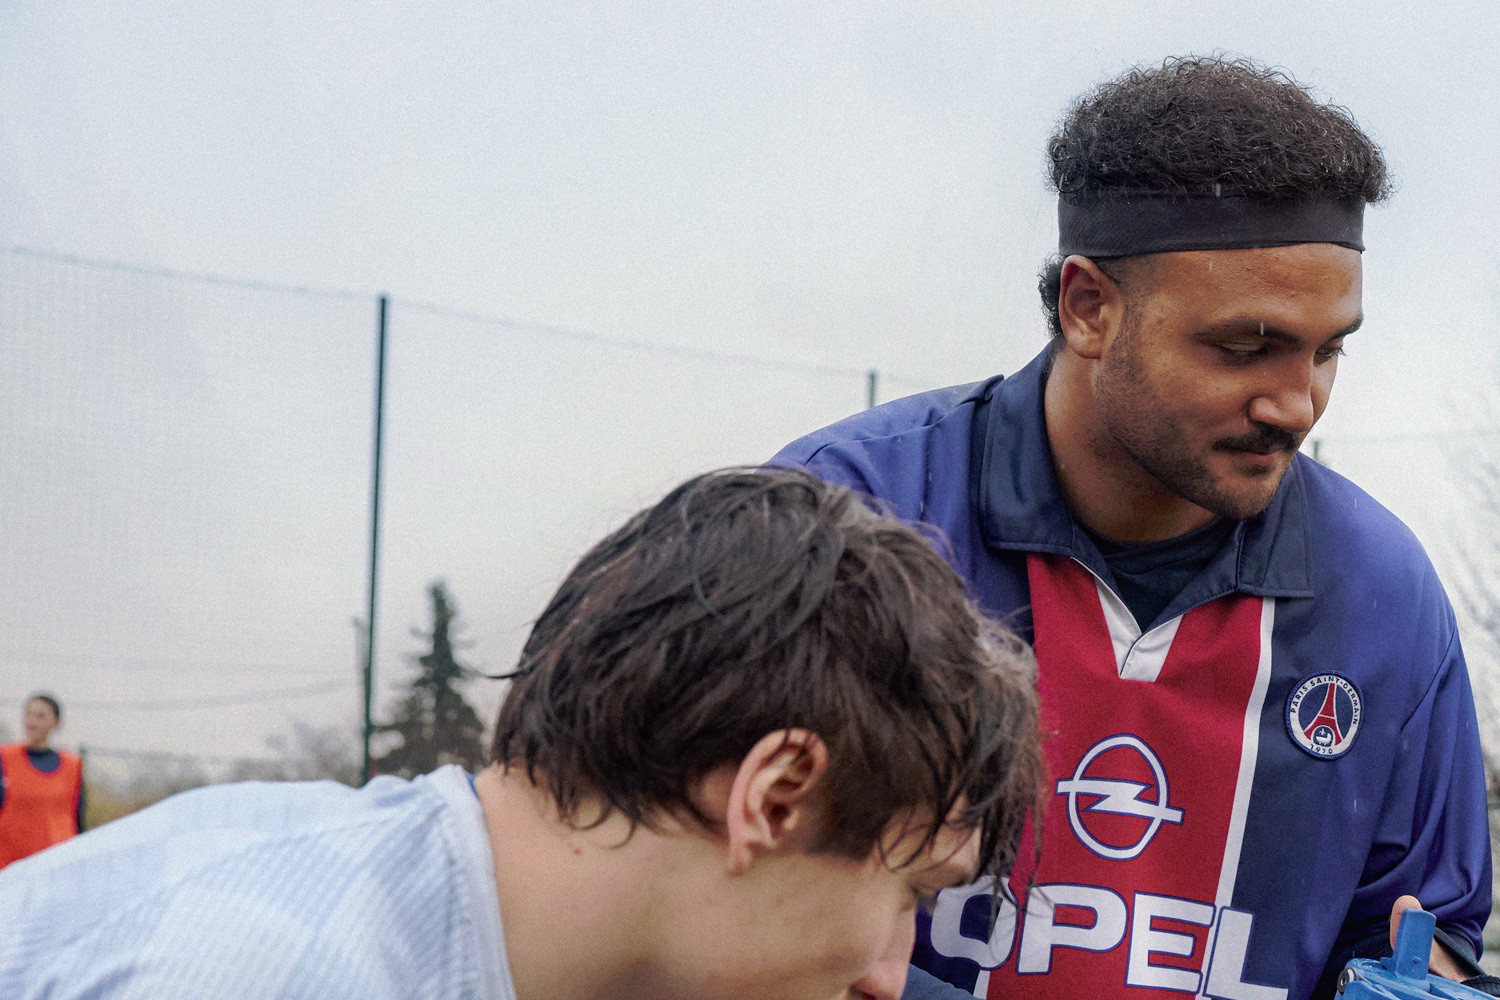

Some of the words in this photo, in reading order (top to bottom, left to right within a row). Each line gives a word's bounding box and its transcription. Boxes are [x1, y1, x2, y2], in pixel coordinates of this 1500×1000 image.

[1290, 686, 1308, 713] PARIS
[1310, 676, 1359, 724] SAINT-GERMAIN
[1310, 743, 1333, 754] 1970
